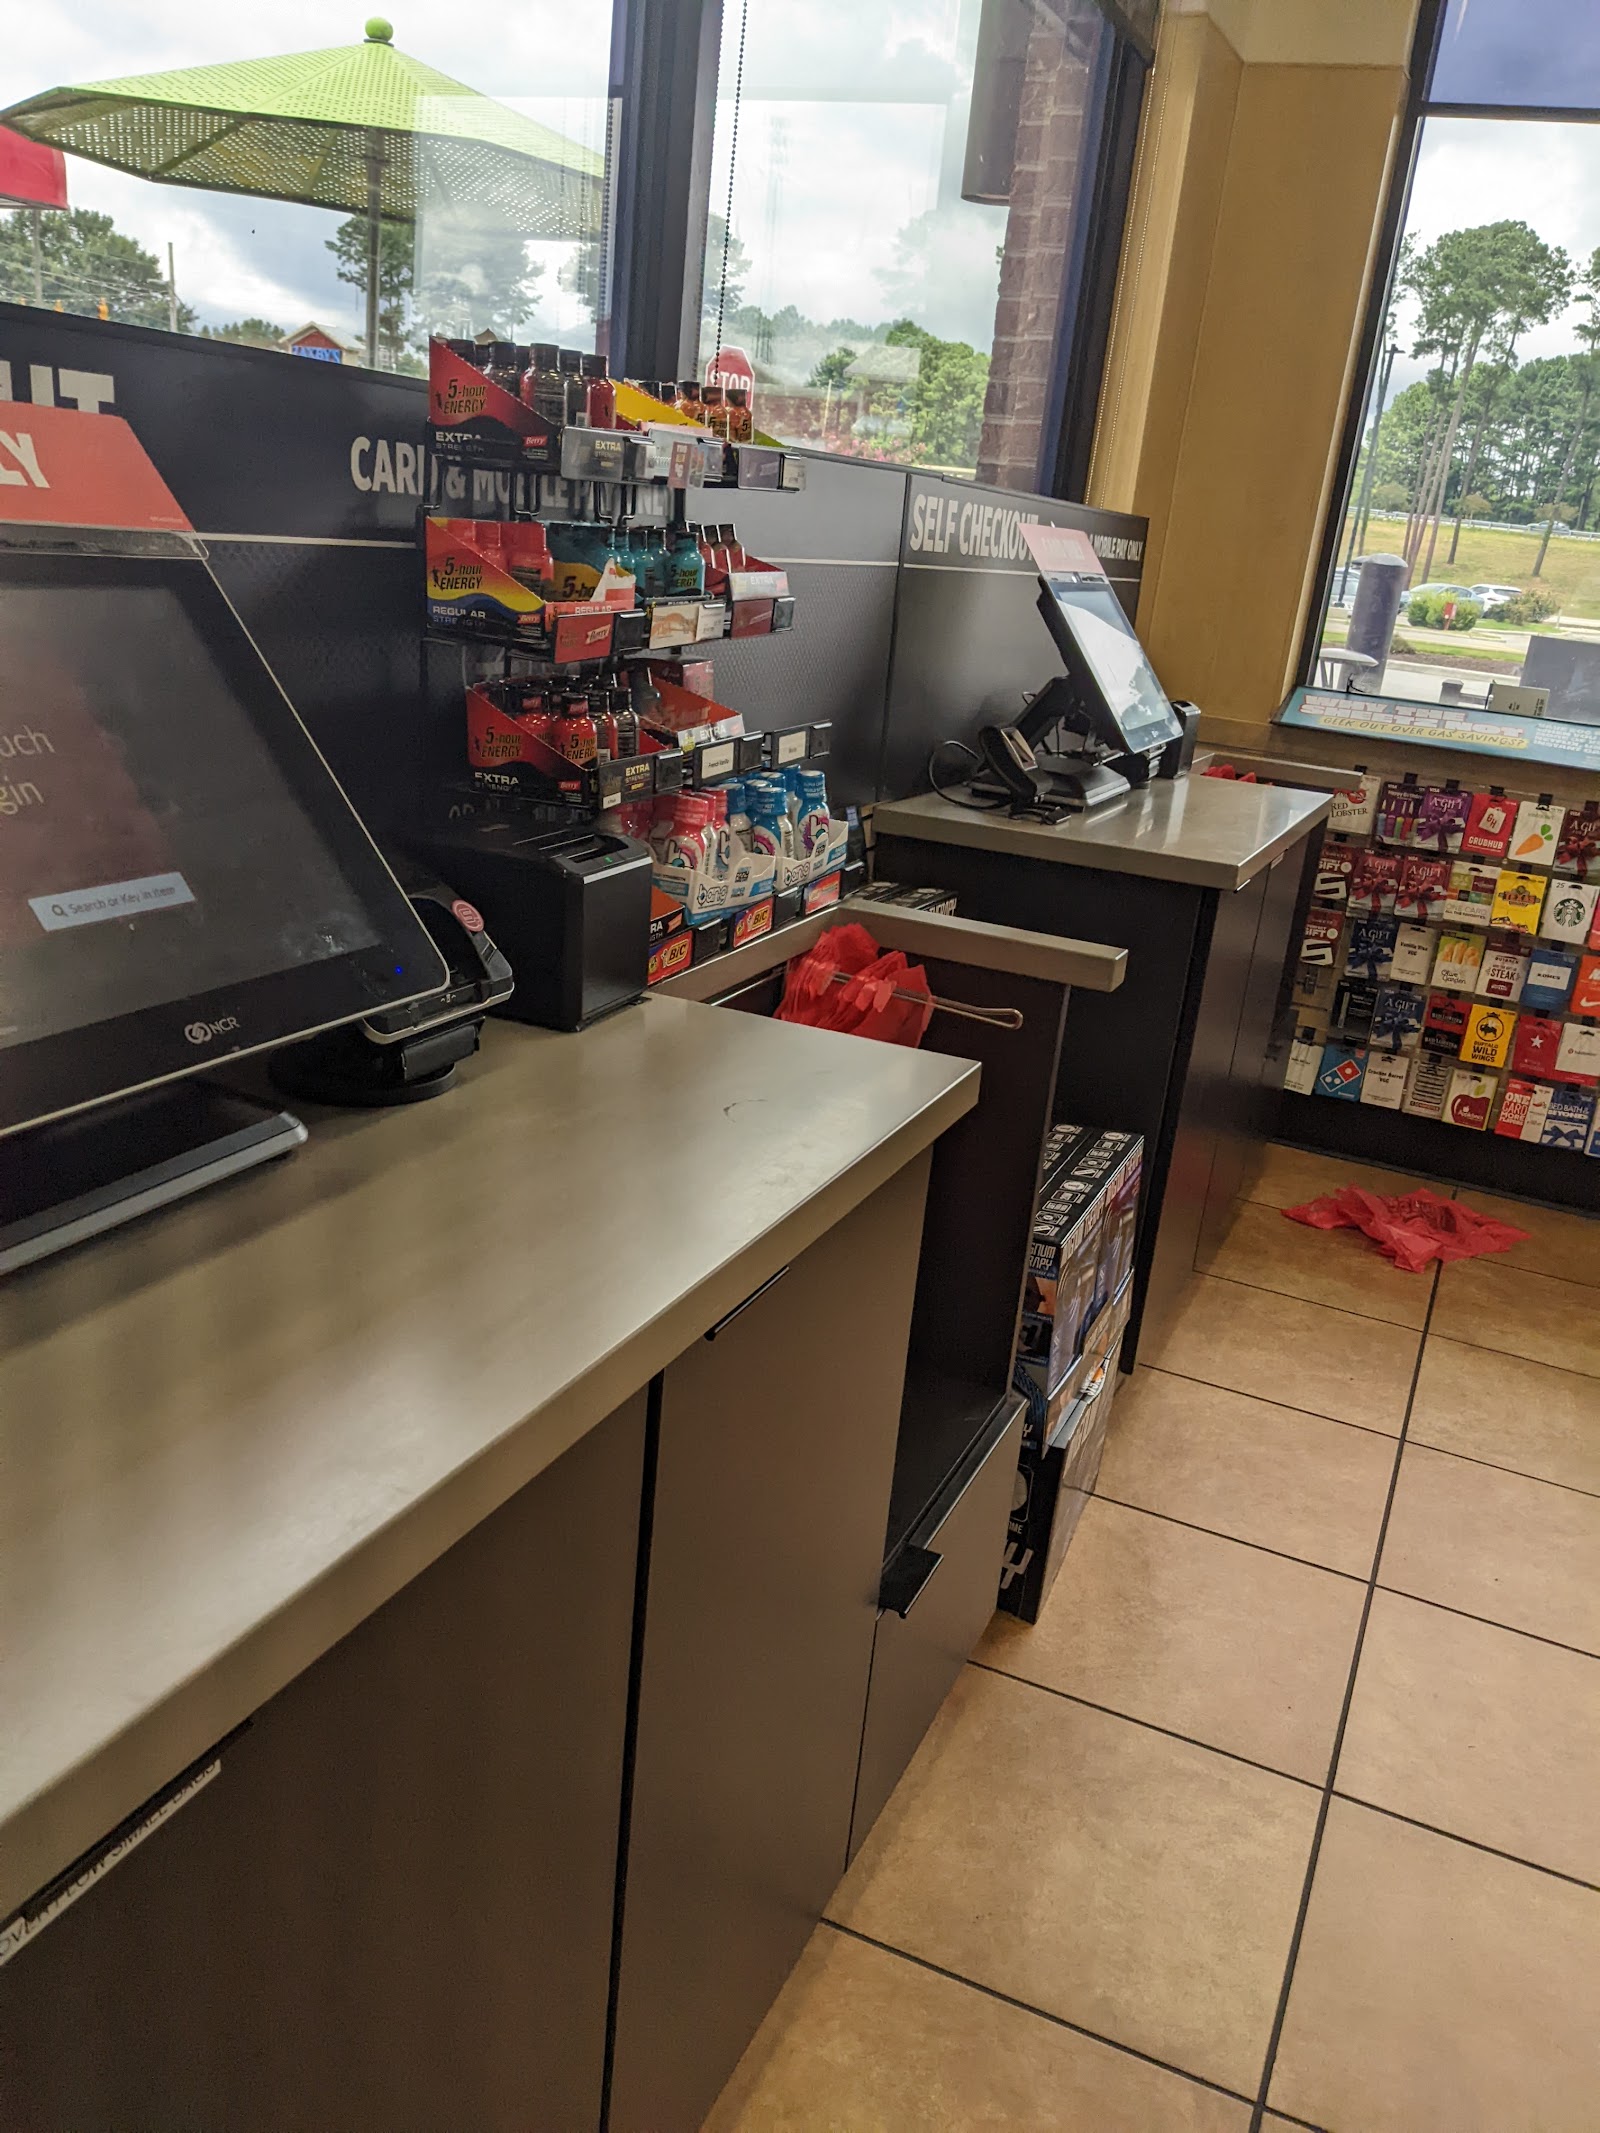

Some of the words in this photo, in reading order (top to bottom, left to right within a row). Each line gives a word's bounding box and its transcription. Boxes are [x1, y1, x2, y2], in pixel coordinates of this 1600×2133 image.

[443, 398, 486, 415] ENERGY
[525, 436, 545, 447] Berry
[594, 440, 622, 451] EXTRA
[909, 493, 958, 554] SELF
[959, 501, 1040, 562] CHECKOUT
[440, 576, 483, 591] ENERGY
[1394, 705, 1468, 722] THE
[1323, 716, 1356, 728] GEEK
[1359, 720, 1389, 732] OUT
[1391, 724, 1425, 737] OVER
[1428, 728, 1453, 739] GAS
[1457, 731, 1526, 747] SAVINGS?
[481, 744, 522, 758] ENERGY
[625, 763, 651, 776] EXTRA
[1331, 802, 1349, 810] RED
[1331, 808, 1368, 818] LOBSTER
[1468, 836, 1504, 850] GRUBHUB
[782, 861, 811, 887] bang
[1555, 881, 1566, 889] 25
[696, 883, 729, 907] bang
[68, 898, 107, 915] Search
[121, 893, 141, 906] Key
[753, 909, 769, 927] BIC
[669, 943, 687, 962] BIC
[1490, 967, 1518, 981] STEAK
[208, 1016, 240, 1035] NCR
[1472, 1046, 1498, 1056] WILD
[1473, 1041, 1499, 1049] BUFFALO
[1471, 1053, 1495, 1063] WINGS
[1505, 1091, 1531, 1105] ONE
[1502, 1100, 1529, 1116] CARD
[1547, 1109, 1589, 1120] BEYOND
[1563, 1104, 1583, 1114] BATH
[1501, 1110, 1526, 1121] MORE
